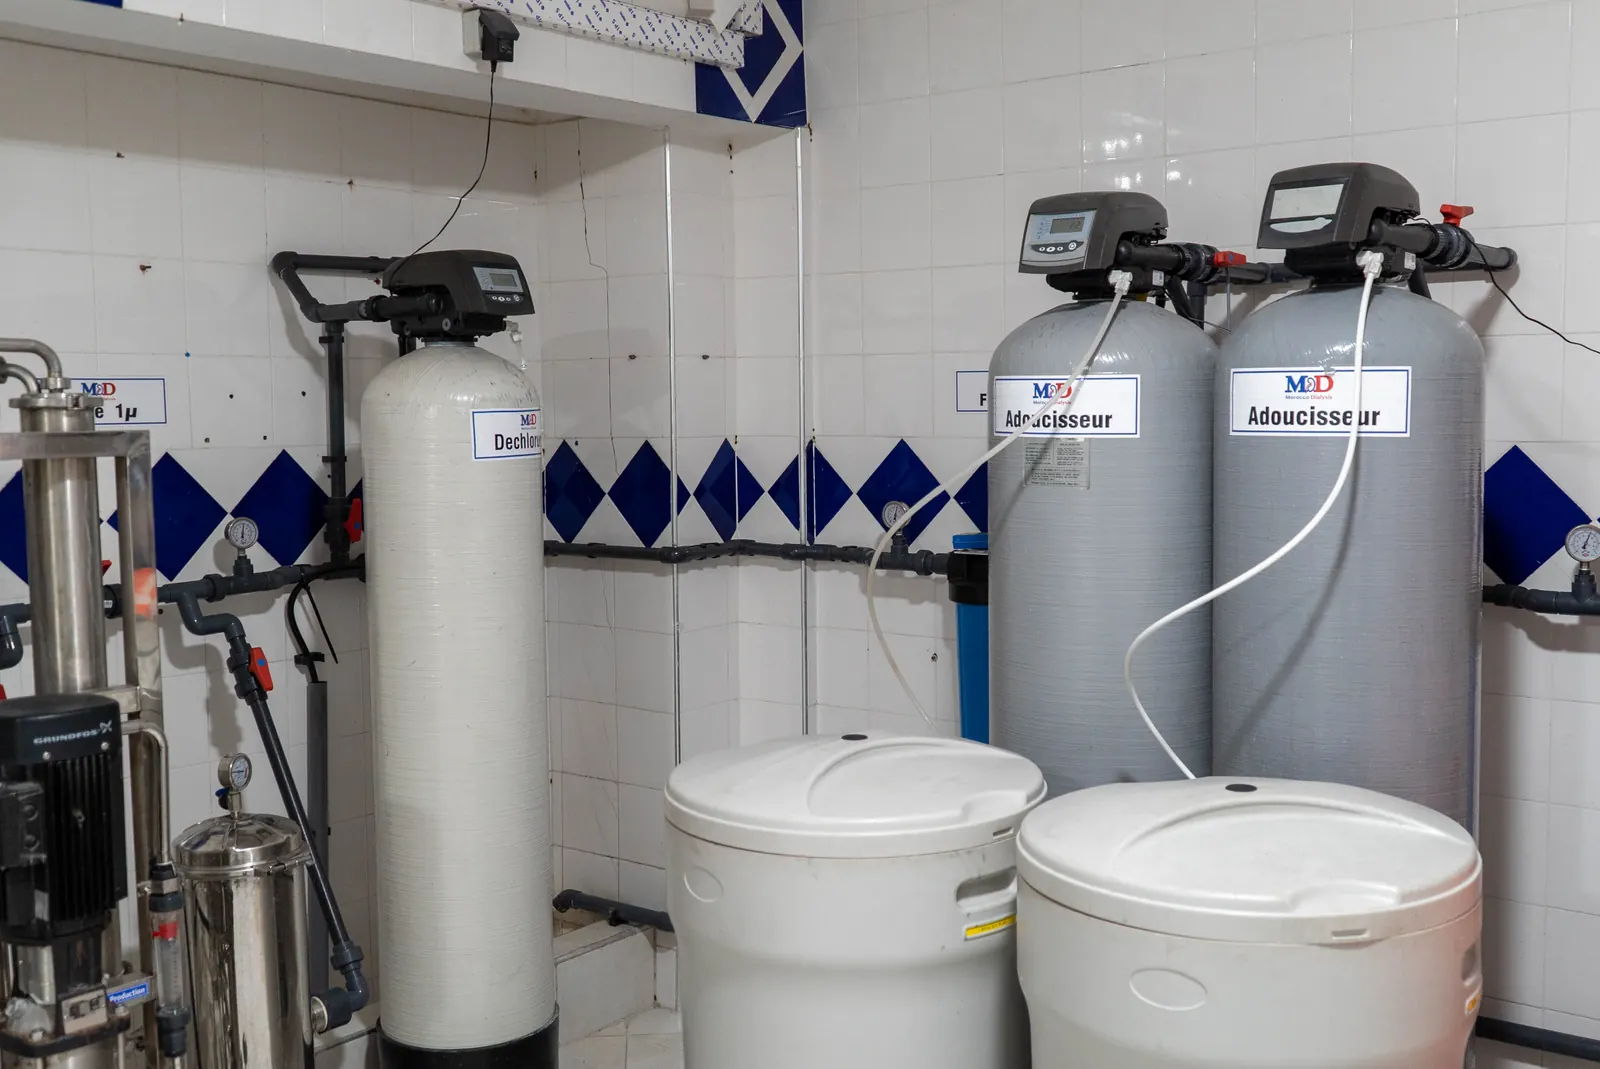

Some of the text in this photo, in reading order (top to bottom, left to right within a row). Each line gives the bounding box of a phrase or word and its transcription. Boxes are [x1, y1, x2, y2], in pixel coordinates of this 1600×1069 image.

[1248, 406, 1381, 426] Adoucisseur
[33, 729, 98, 745] GRUNDFOS
[109, 987, 146, 1003] Production
